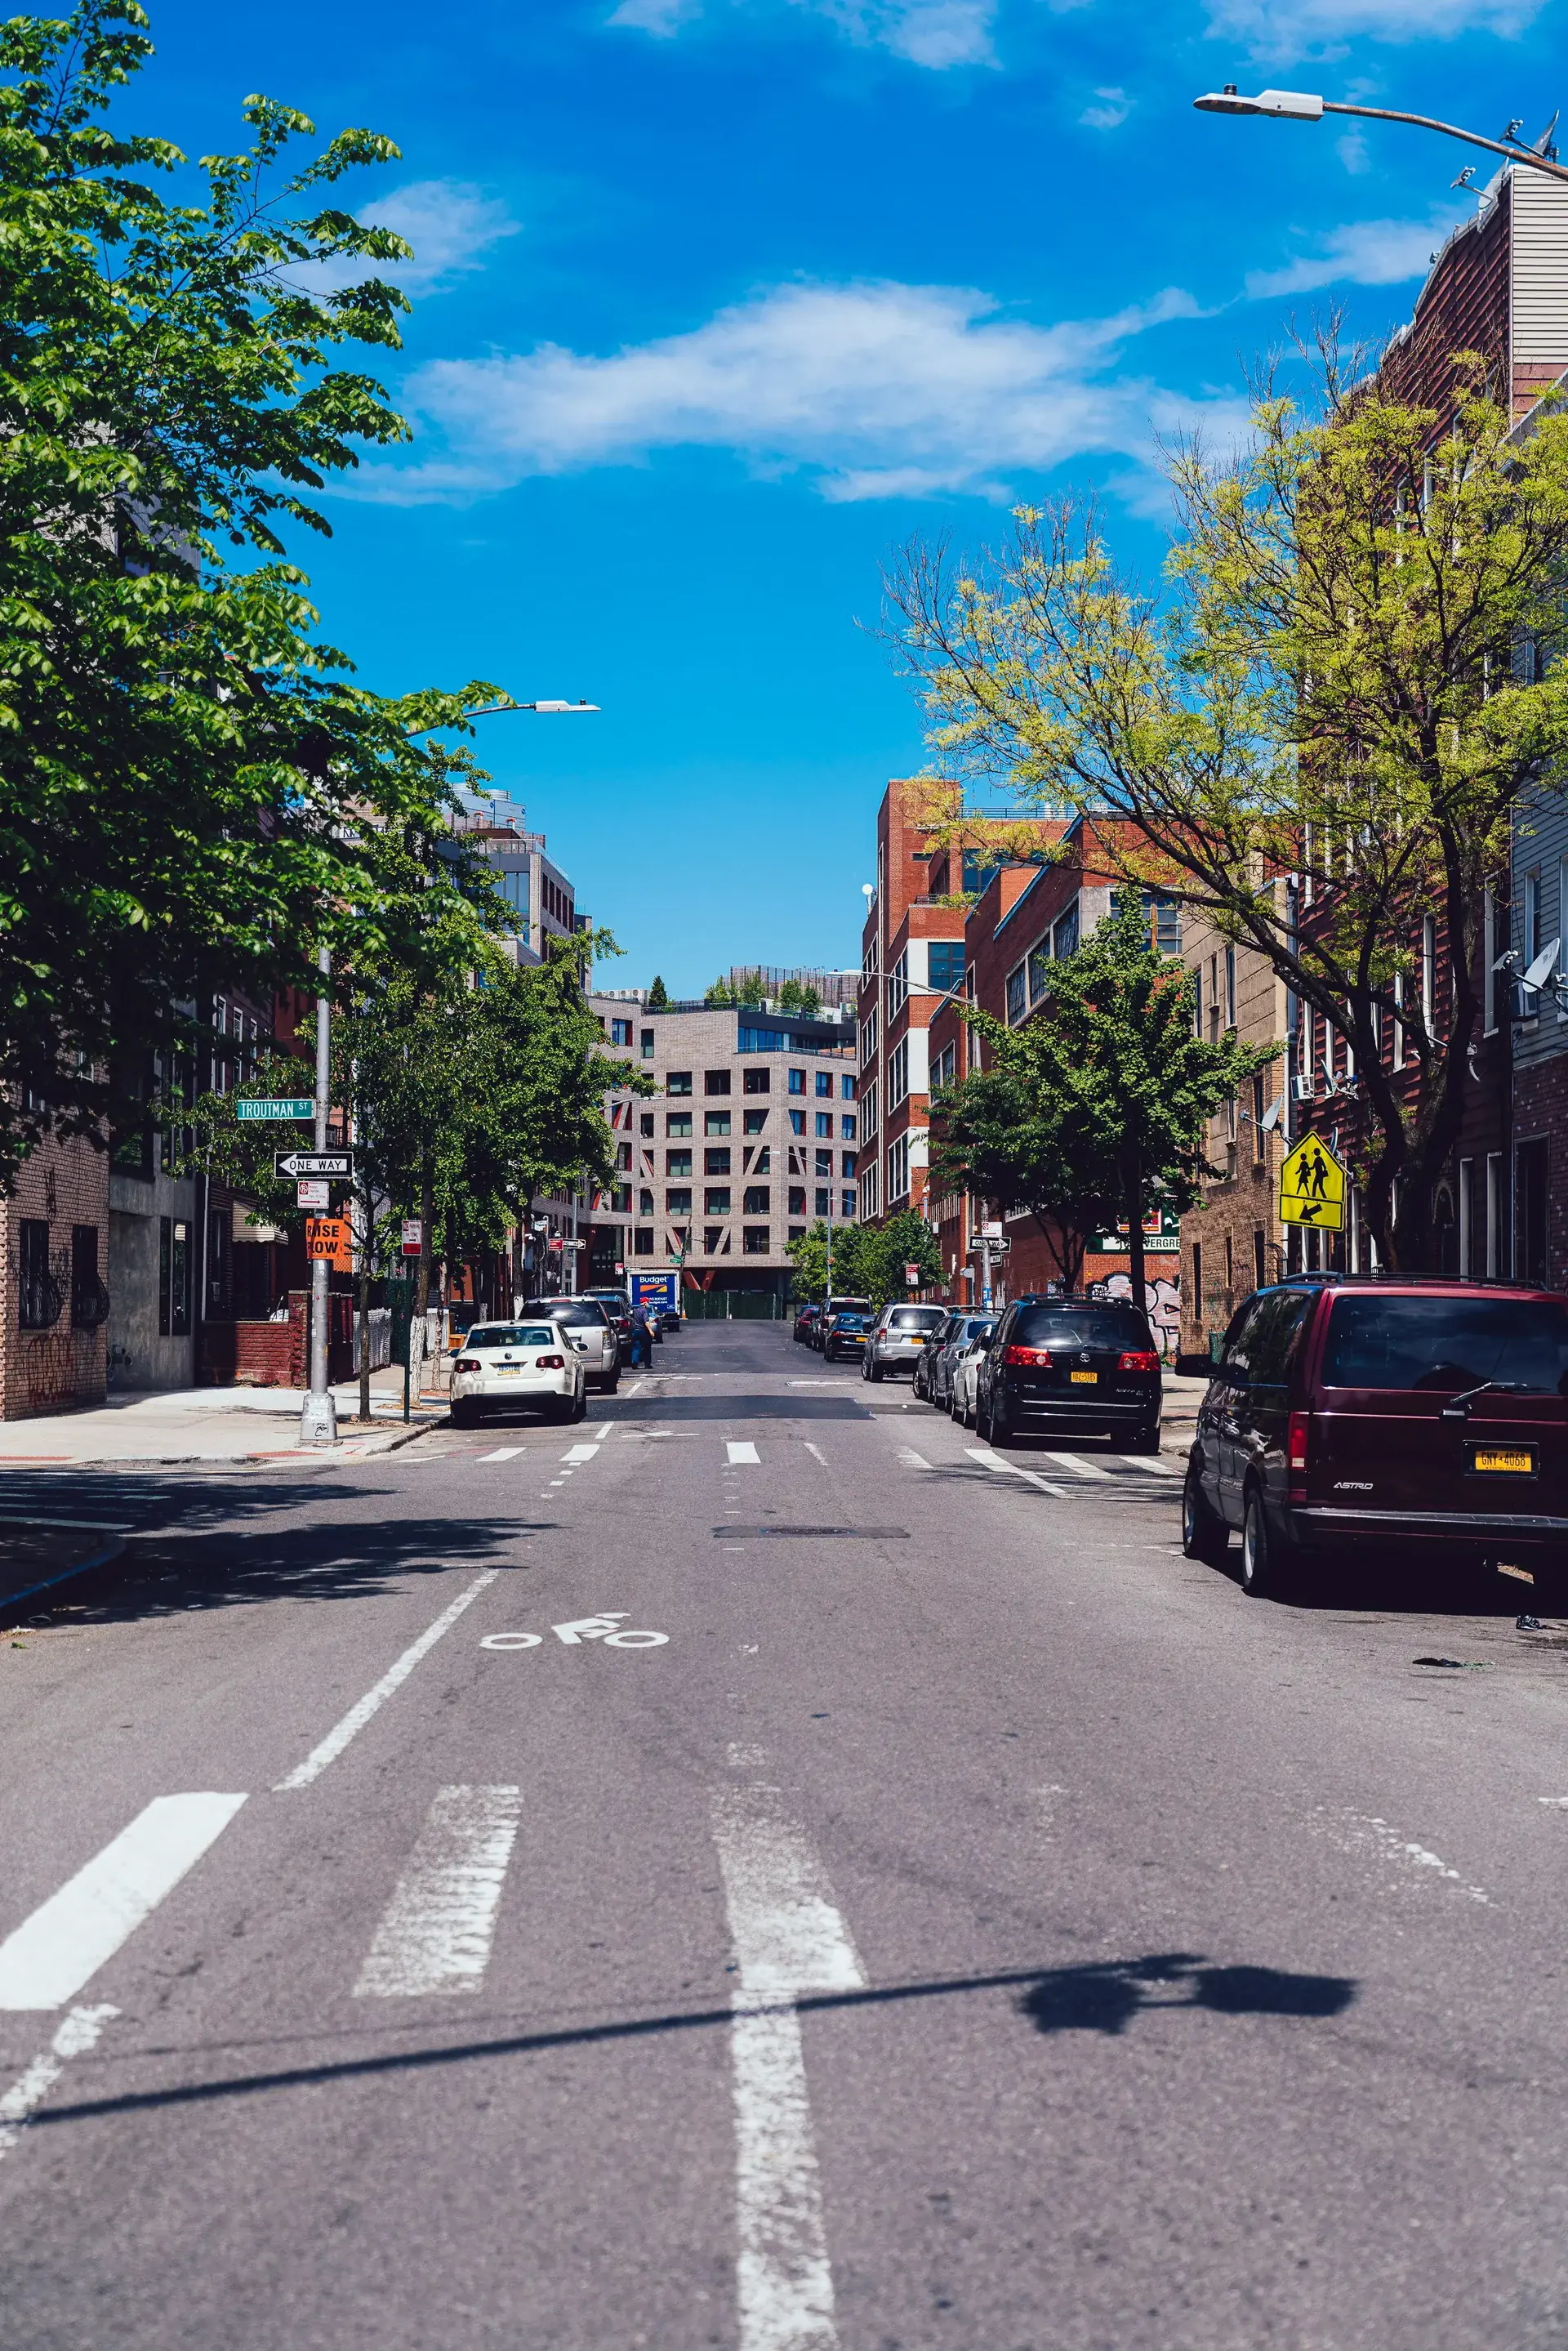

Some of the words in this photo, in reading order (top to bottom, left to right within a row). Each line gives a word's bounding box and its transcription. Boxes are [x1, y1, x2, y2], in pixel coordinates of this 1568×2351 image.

[241, 1103, 294, 1118] TROUTMAN
[289, 1160, 312, 1170] ONE
[318, 1160, 341, 1170] WAY
[639, 1276, 667, 1284] Budget
[1333, 1482, 1374, 1490] ASTRO
